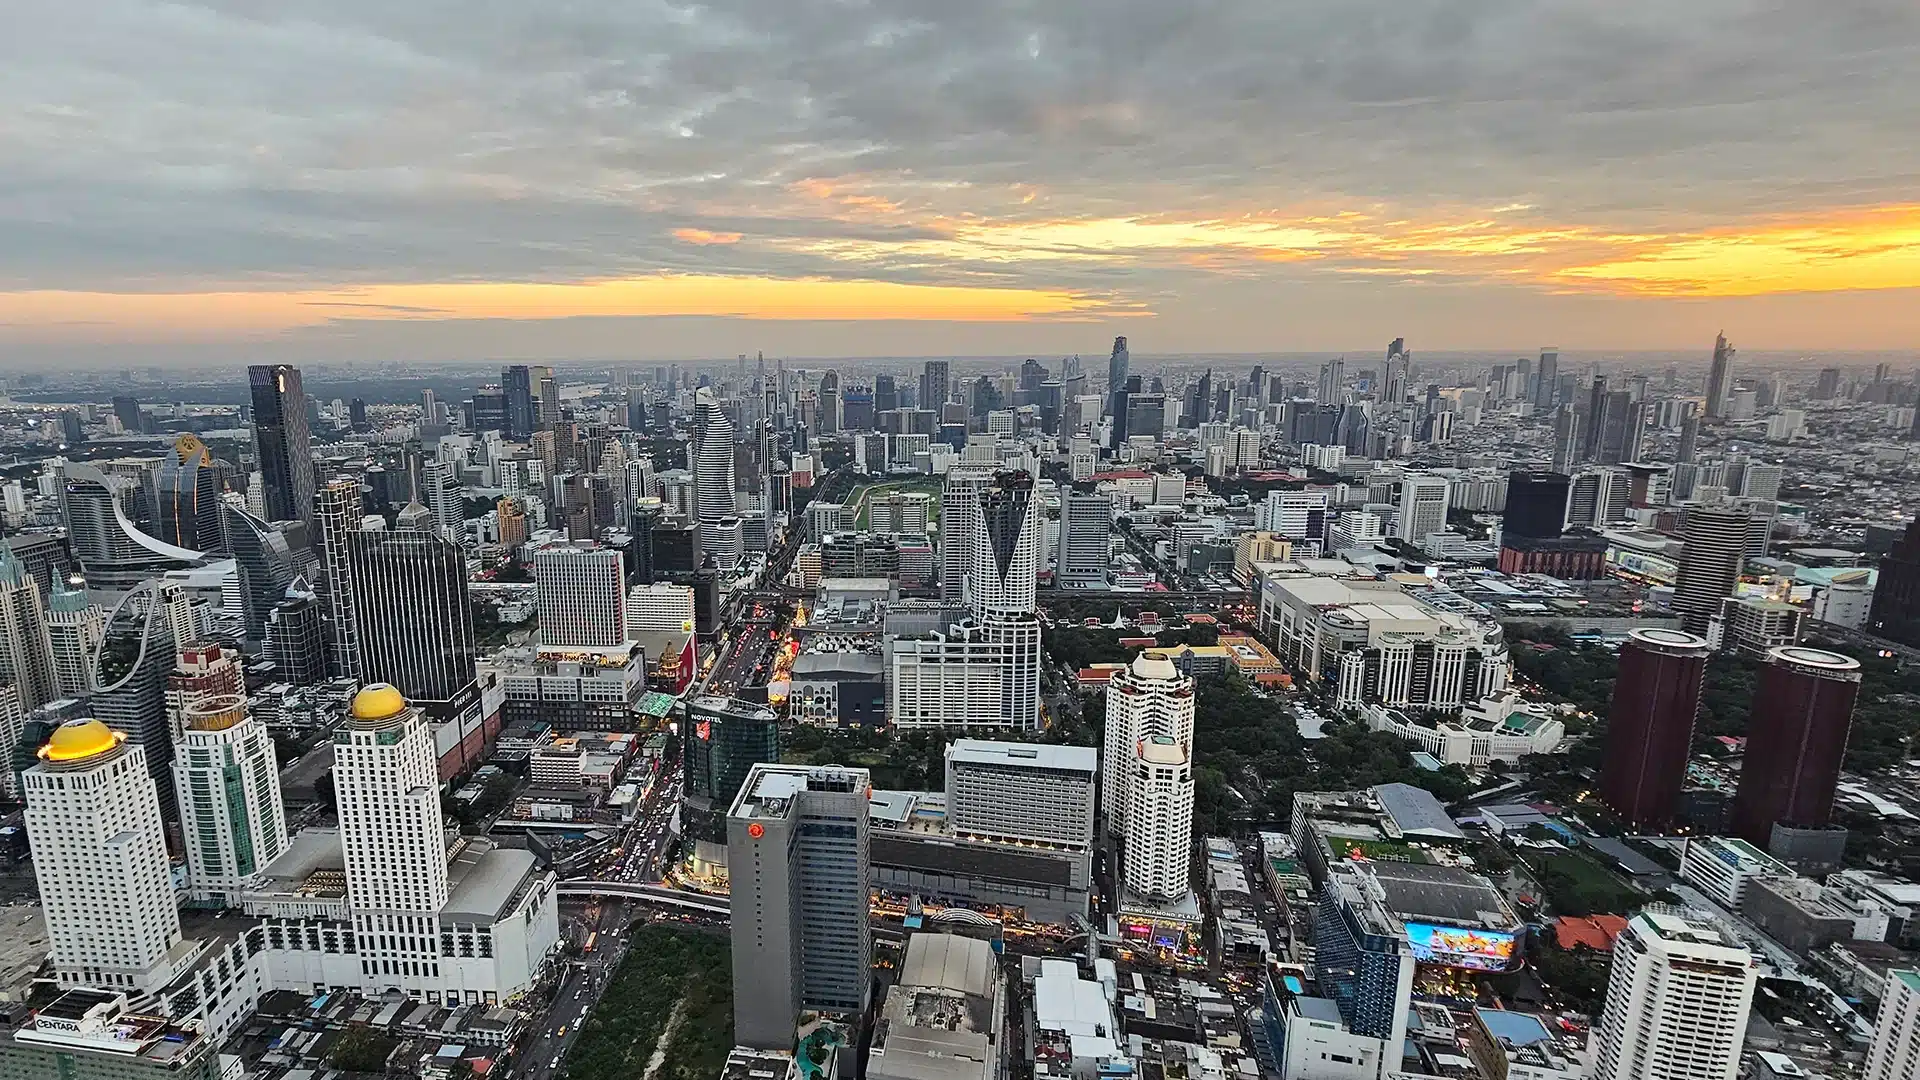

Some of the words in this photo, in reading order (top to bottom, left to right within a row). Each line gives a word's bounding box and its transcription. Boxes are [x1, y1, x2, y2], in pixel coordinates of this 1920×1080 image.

[690, 713, 723, 724] NOVOTEL
[1145, 909, 1176, 917] DIAMOND
[36, 1018, 81, 1032] CENTARA
